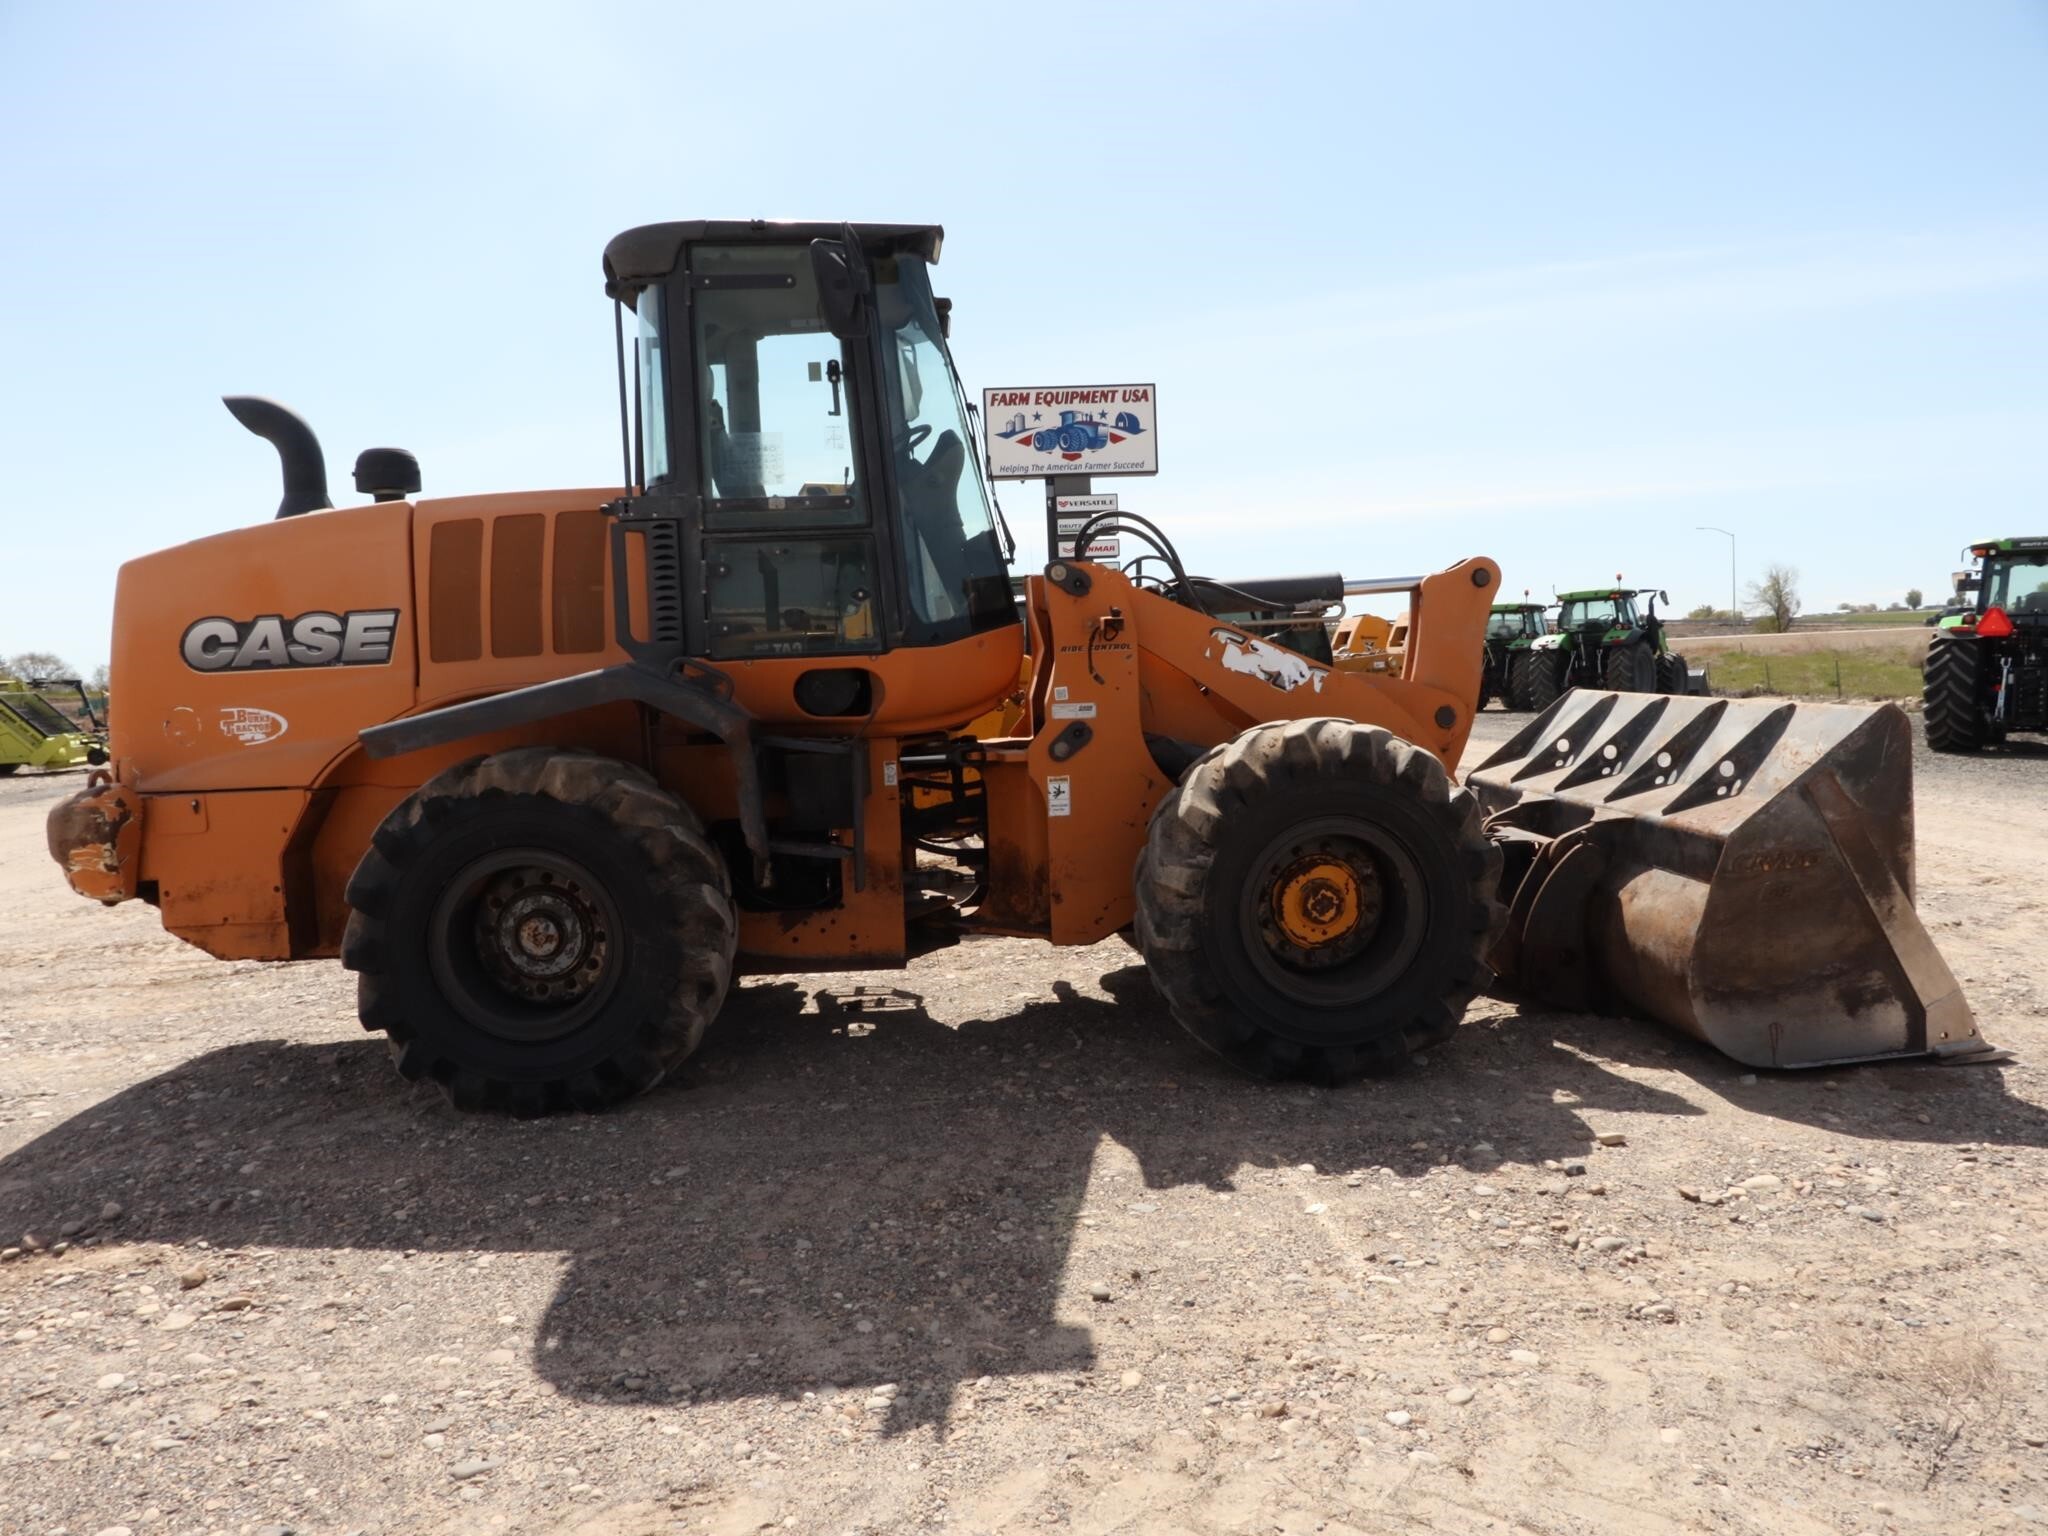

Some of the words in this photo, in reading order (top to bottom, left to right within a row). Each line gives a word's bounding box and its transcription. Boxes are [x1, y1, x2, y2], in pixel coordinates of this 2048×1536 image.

[990, 392, 1030, 407] FARM
[1035, 390, 1118, 407] EQUIPMENT
[1122, 389, 1149, 403] USA
[1000, 464, 1029, 474] Helping
[1031, 463, 1045, 472] The
[1046, 462, 1082, 472] American
[1085, 461, 1111, 471] Farmer
[1112, 460, 1145, 470] Succeed
[1069, 499, 1115, 507] VERSATILE
[183, 612, 397, 670] CASE
